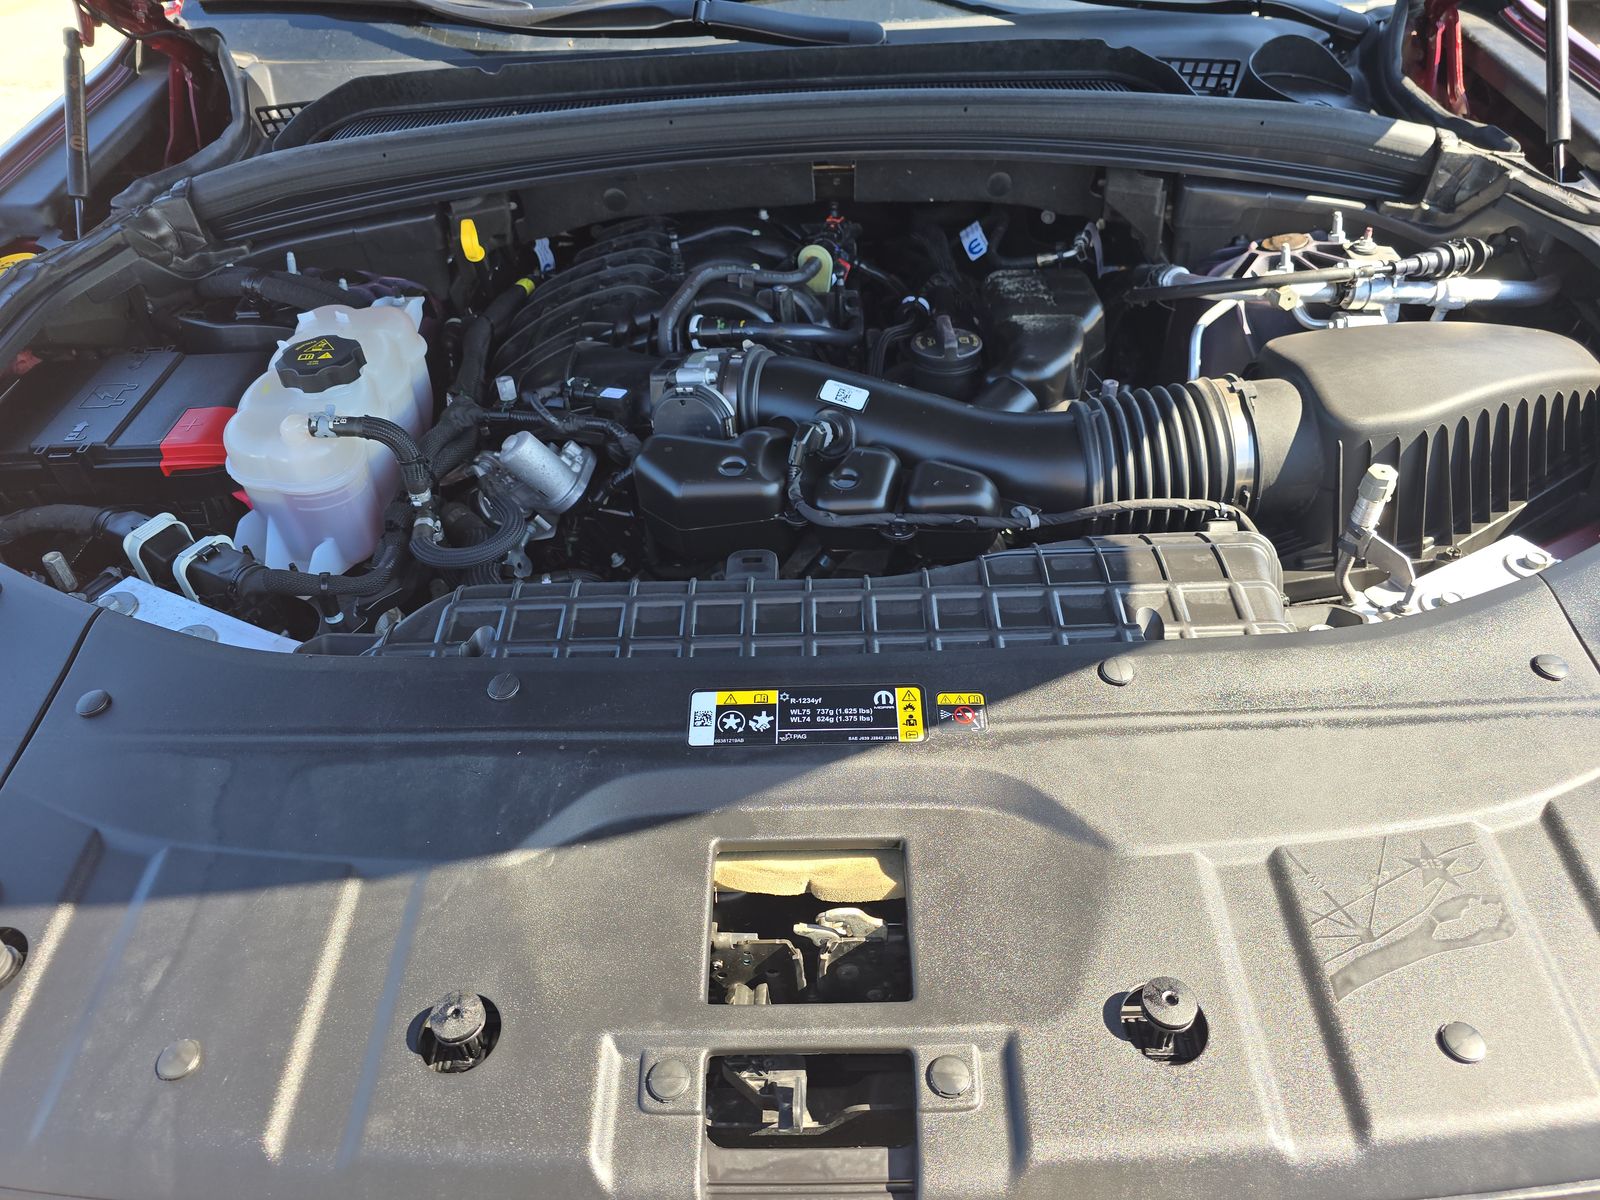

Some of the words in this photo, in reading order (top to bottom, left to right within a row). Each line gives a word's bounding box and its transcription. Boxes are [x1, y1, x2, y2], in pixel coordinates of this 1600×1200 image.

[790, 697, 822, 705] R-1234yf
[816, 708, 834, 716] 737g
[858, 707, 873, 715] lbs)
[816, 716, 834, 724] 624g
[835, 715, 858, 723] (1.375
[858, 715, 874, 723] lbs)
